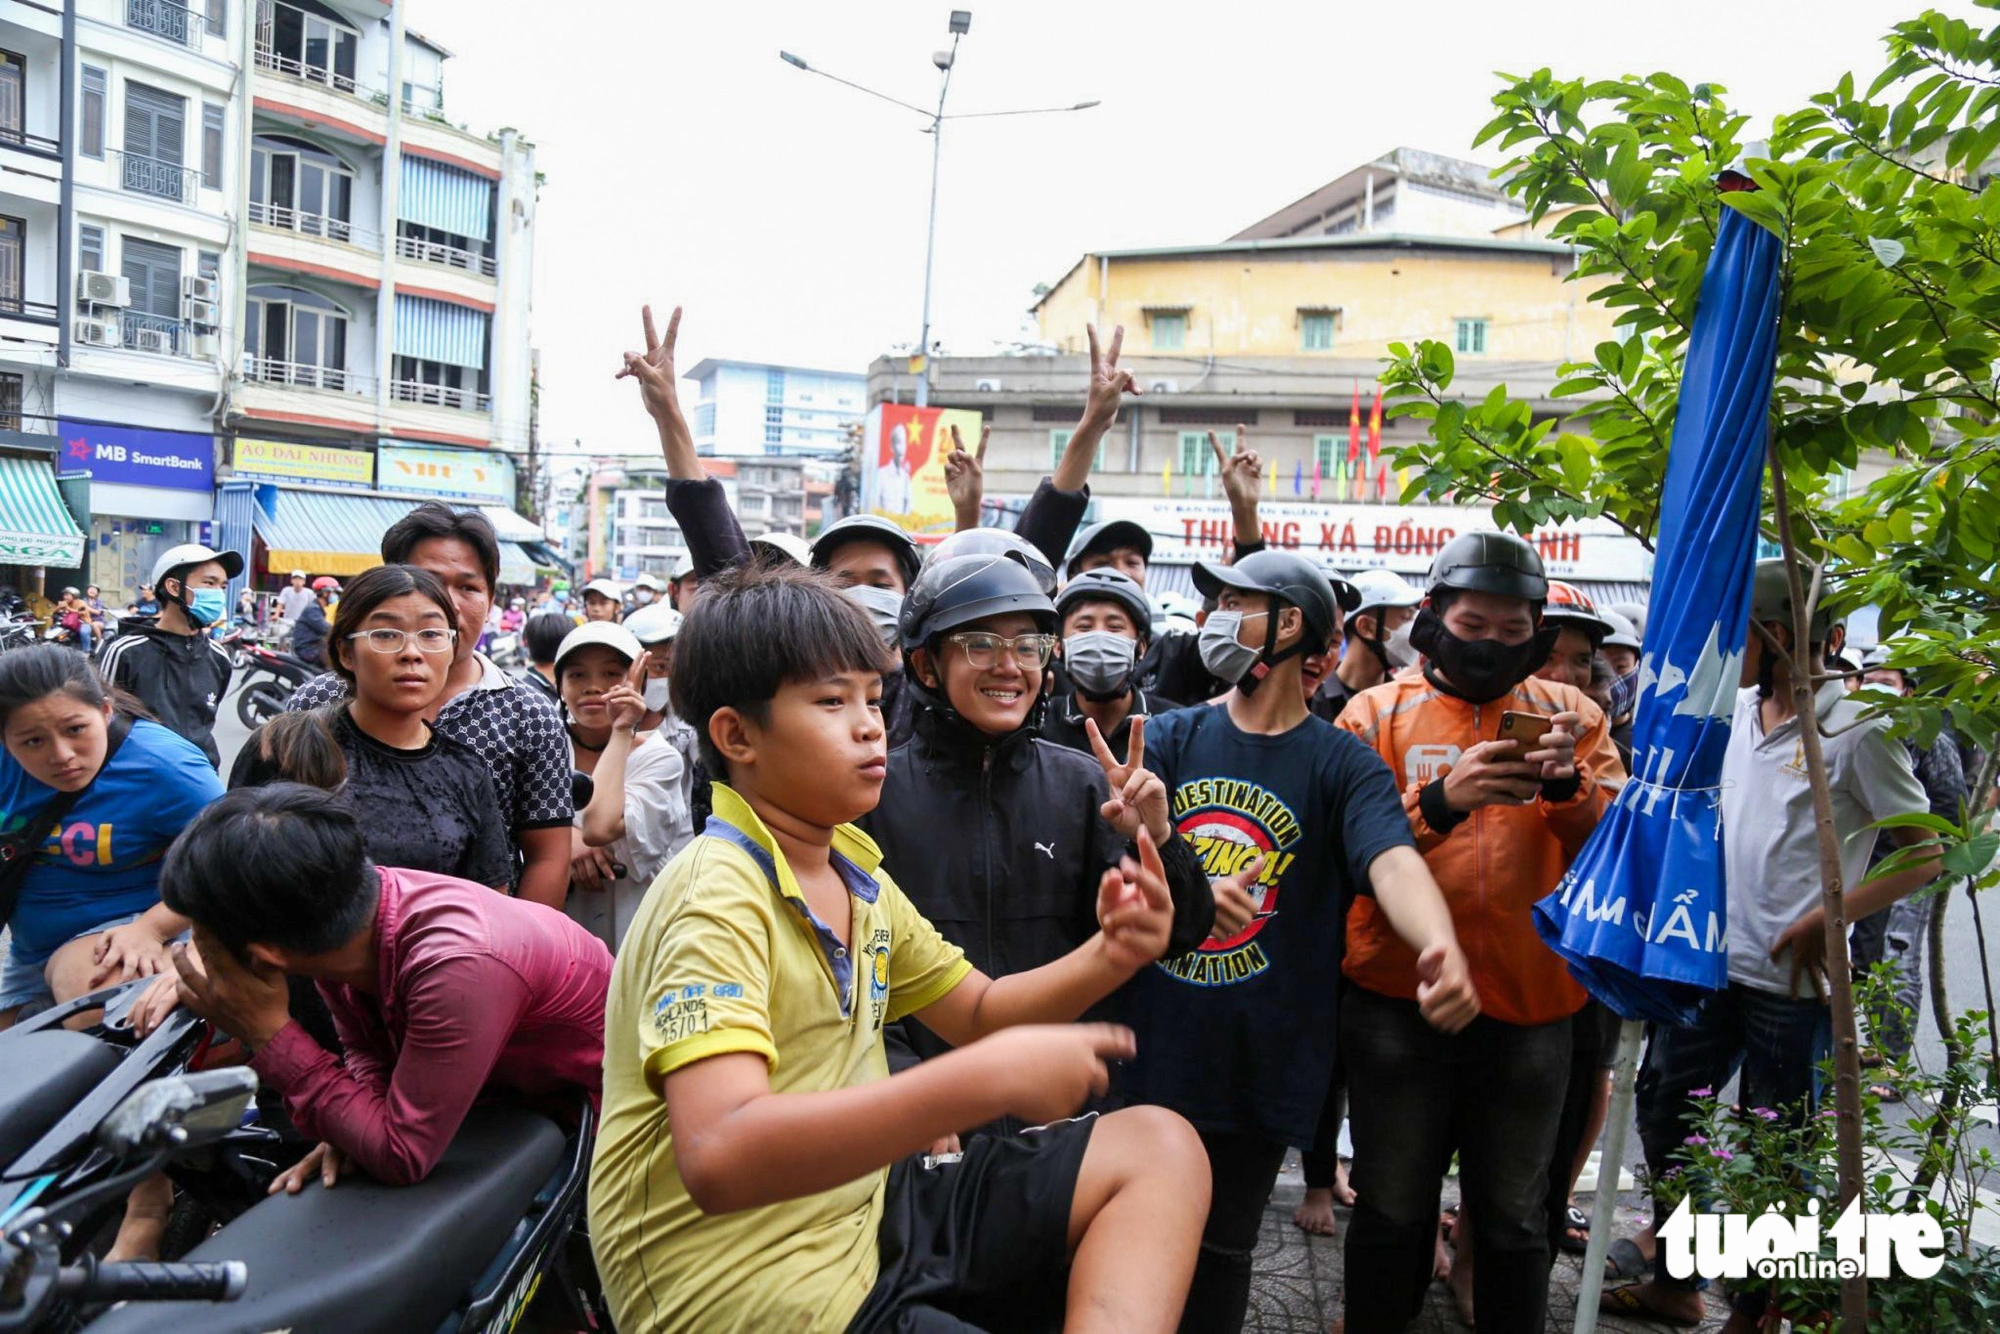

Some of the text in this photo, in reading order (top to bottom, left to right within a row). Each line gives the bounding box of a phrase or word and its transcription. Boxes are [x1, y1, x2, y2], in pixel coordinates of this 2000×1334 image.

[95, 444, 203, 470] MB SmartBank
[1319, 517, 1358, 552] XÁ
[1173, 778, 1302, 850] DESTINATION
